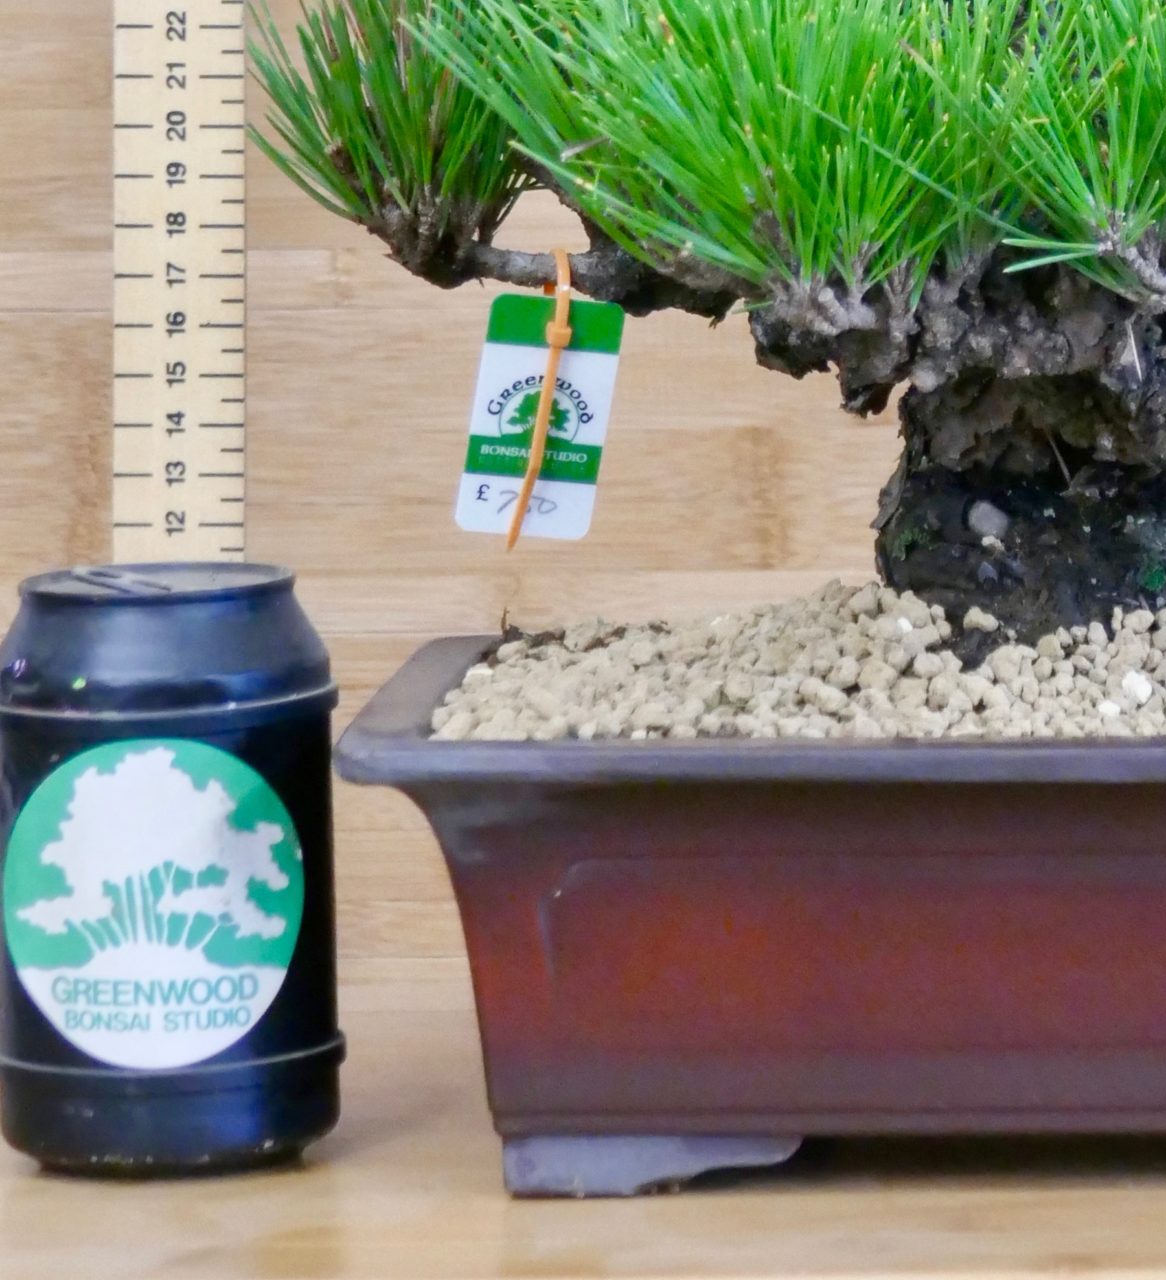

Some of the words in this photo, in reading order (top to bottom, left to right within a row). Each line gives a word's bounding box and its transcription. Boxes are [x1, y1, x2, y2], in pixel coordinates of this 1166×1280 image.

[165, 11, 186, 41] 22
[166, 62, 186, 89] 21
[165, 110, 186, 141] 20
[166, 162, 186, 187] 19
[165, 211, 187, 237] 18
[166, 262, 186, 287] 17
[165, 311, 186, 338] 16
[165, 361, 186, 387] 15
[165, 411, 185, 436] 14
[543, 449, 588, 463] TUDIO
[165, 461, 186, 486] 13
[165, 511, 185, 536] 12
[51, 973, 260, 1006] GREENWOOD
[64, 1009, 151, 1032] BONSAI
[164, 1006, 251, 1032] STUDIO
